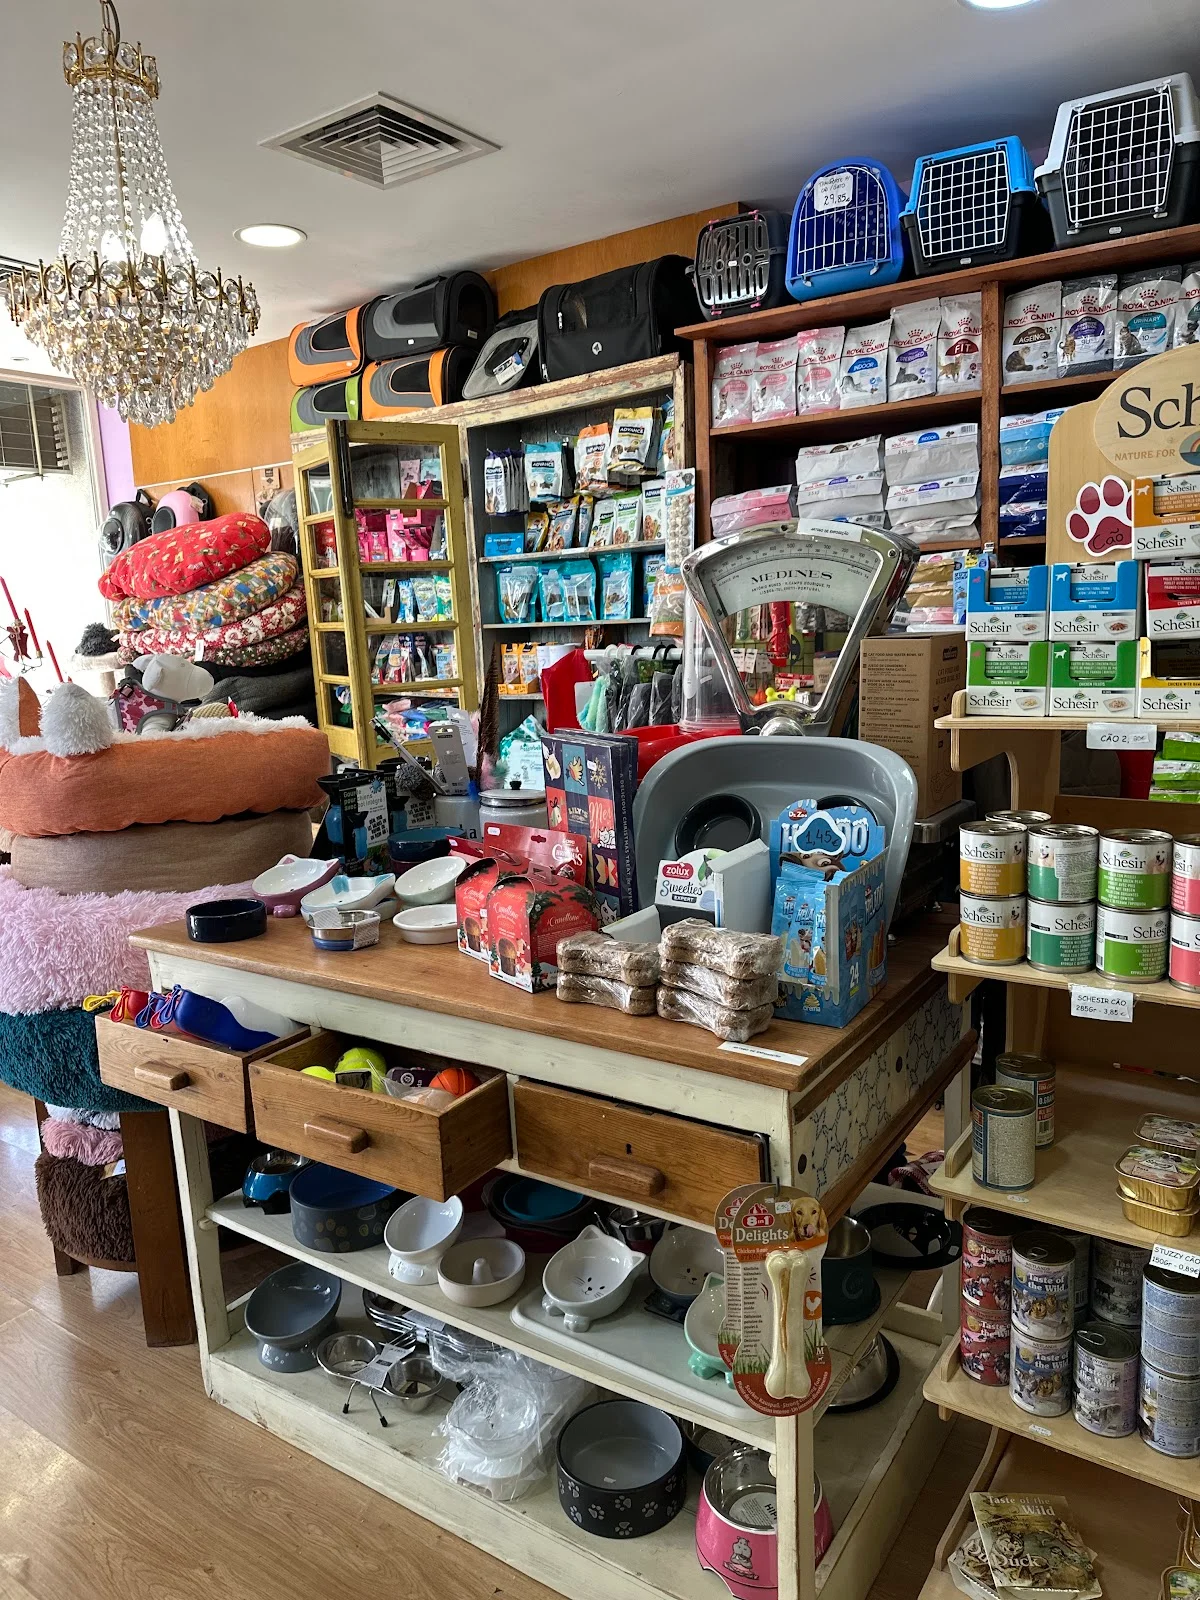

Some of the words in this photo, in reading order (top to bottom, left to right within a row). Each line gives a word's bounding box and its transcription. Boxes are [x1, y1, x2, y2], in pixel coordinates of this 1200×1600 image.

[1122, 302, 1146, 310] ROYAL
[1147, 297, 1174, 308] CANIN
[1064, 307, 1086, 316] ROYAL
[1088, 304, 1112, 314] CANIN
[1008, 316, 1029, 326] ROYAL
[1030, 312, 1055, 322] CANIN
[1133, 316, 1162, 324] URINARY
[914, 332, 934, 343] CANIN
[943, 330, 962, 338] ROYAL
[1018, 333, 1046, 344] AGEING
[866, 343, 885, 352] CANIN
[954, 342, 971, 354] FIT
[853, 362, 875, 372] INDOOR
[1114, 450, 1154, 461] NATURE
[1156, 448, 1176, 458] FOR
[1166, 484, 1197, 494] Schesir
[1092, 528, 1124, 550] Cão
[1136, 534, 1187, 550] Schesir
[751, 570, 833, 584] MEDINES
[970, 622, 1012, 634] Schesir
[1054, 621, 1100, 633] Schesir
[1082, 652, 1110, 660] Schesir
[970, 695, 1012, 706] Schesir
[1054, 698, 1099, 710] Schesir
[1142, 698, 1192, 710] Schesir
[1100, 733, 1120, 742] CÃO
[619, 779, 627, 816] DELICIOUS
[805, 828, 840, 847] 1,45€
[964, 844, 1006, 860] Schesir
[1102, 852, 1146, 868] Schesir
[666, 866, 690, 877] zolux
[660, 880, 703, 897] Sweeties
[963, 906, 1003, 924] Schesir
[850, 962, 860, 989] 24
[1077, 994, 1110, 1004] SCHESIR
[1110, 994, 1127, 1007] CÃO
[1076, 1004, 1097, 1013] 285Gr
[736, 1228, 789, 1244] Delights
[1154, 1246, 1184, 1260] STUZZY
[1028, 1272, 1054, 1284] Taste
[1056, 1274, 1064, 1284] of
[1028, 1282, 1042, 1291] the
[1045, 1284, 1066, 1292] Wild
[997, 1330, 1010, 1338] Wil
[816, 1348, 824, 1356] M
[1036, 1352, 1060, 1361] Taste
[1034, 1361, 1050, 1370] the
[1052, 1360, 1069, 1370] Wild
[1106, 1372, 1116, 1380] of
[986, 1494, 1016, 1505] Taste
[1019, 1496, 1034, 1505] of
[1036, 1497, 1050, 1506] the
[1021, 1504, 1056, 1517] Wild
[996, 1554, 1041, 1568] Duck
